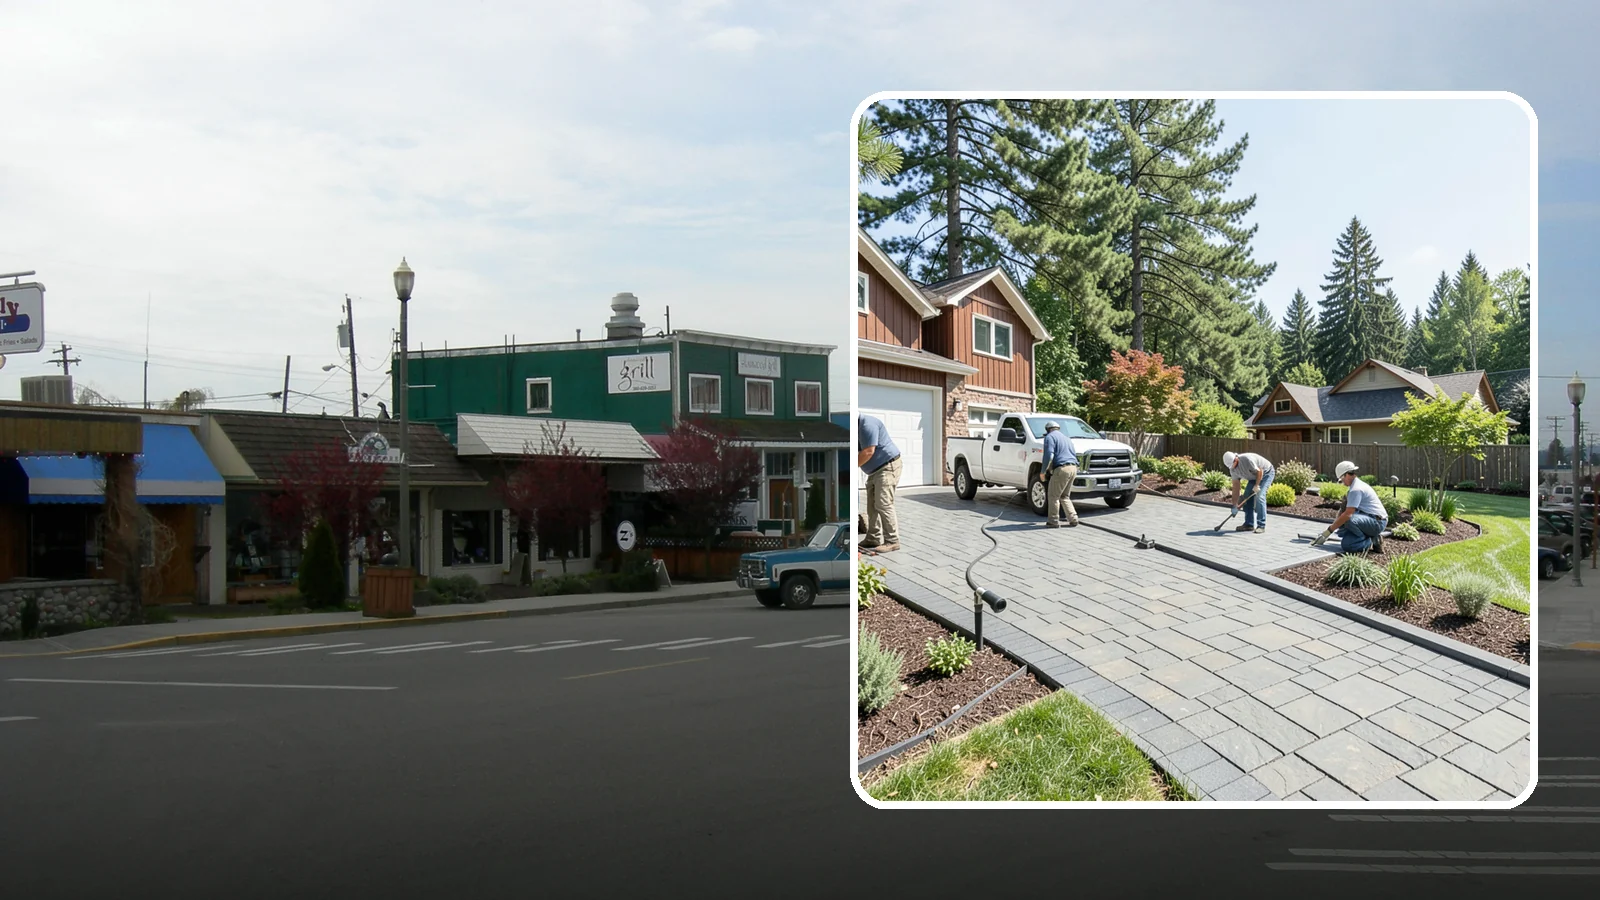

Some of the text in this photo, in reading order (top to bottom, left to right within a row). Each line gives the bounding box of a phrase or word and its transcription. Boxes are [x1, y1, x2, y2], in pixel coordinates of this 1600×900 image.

[3, 337, 38, 346] Fries Salads
[617, 356, 655, 391] grill
